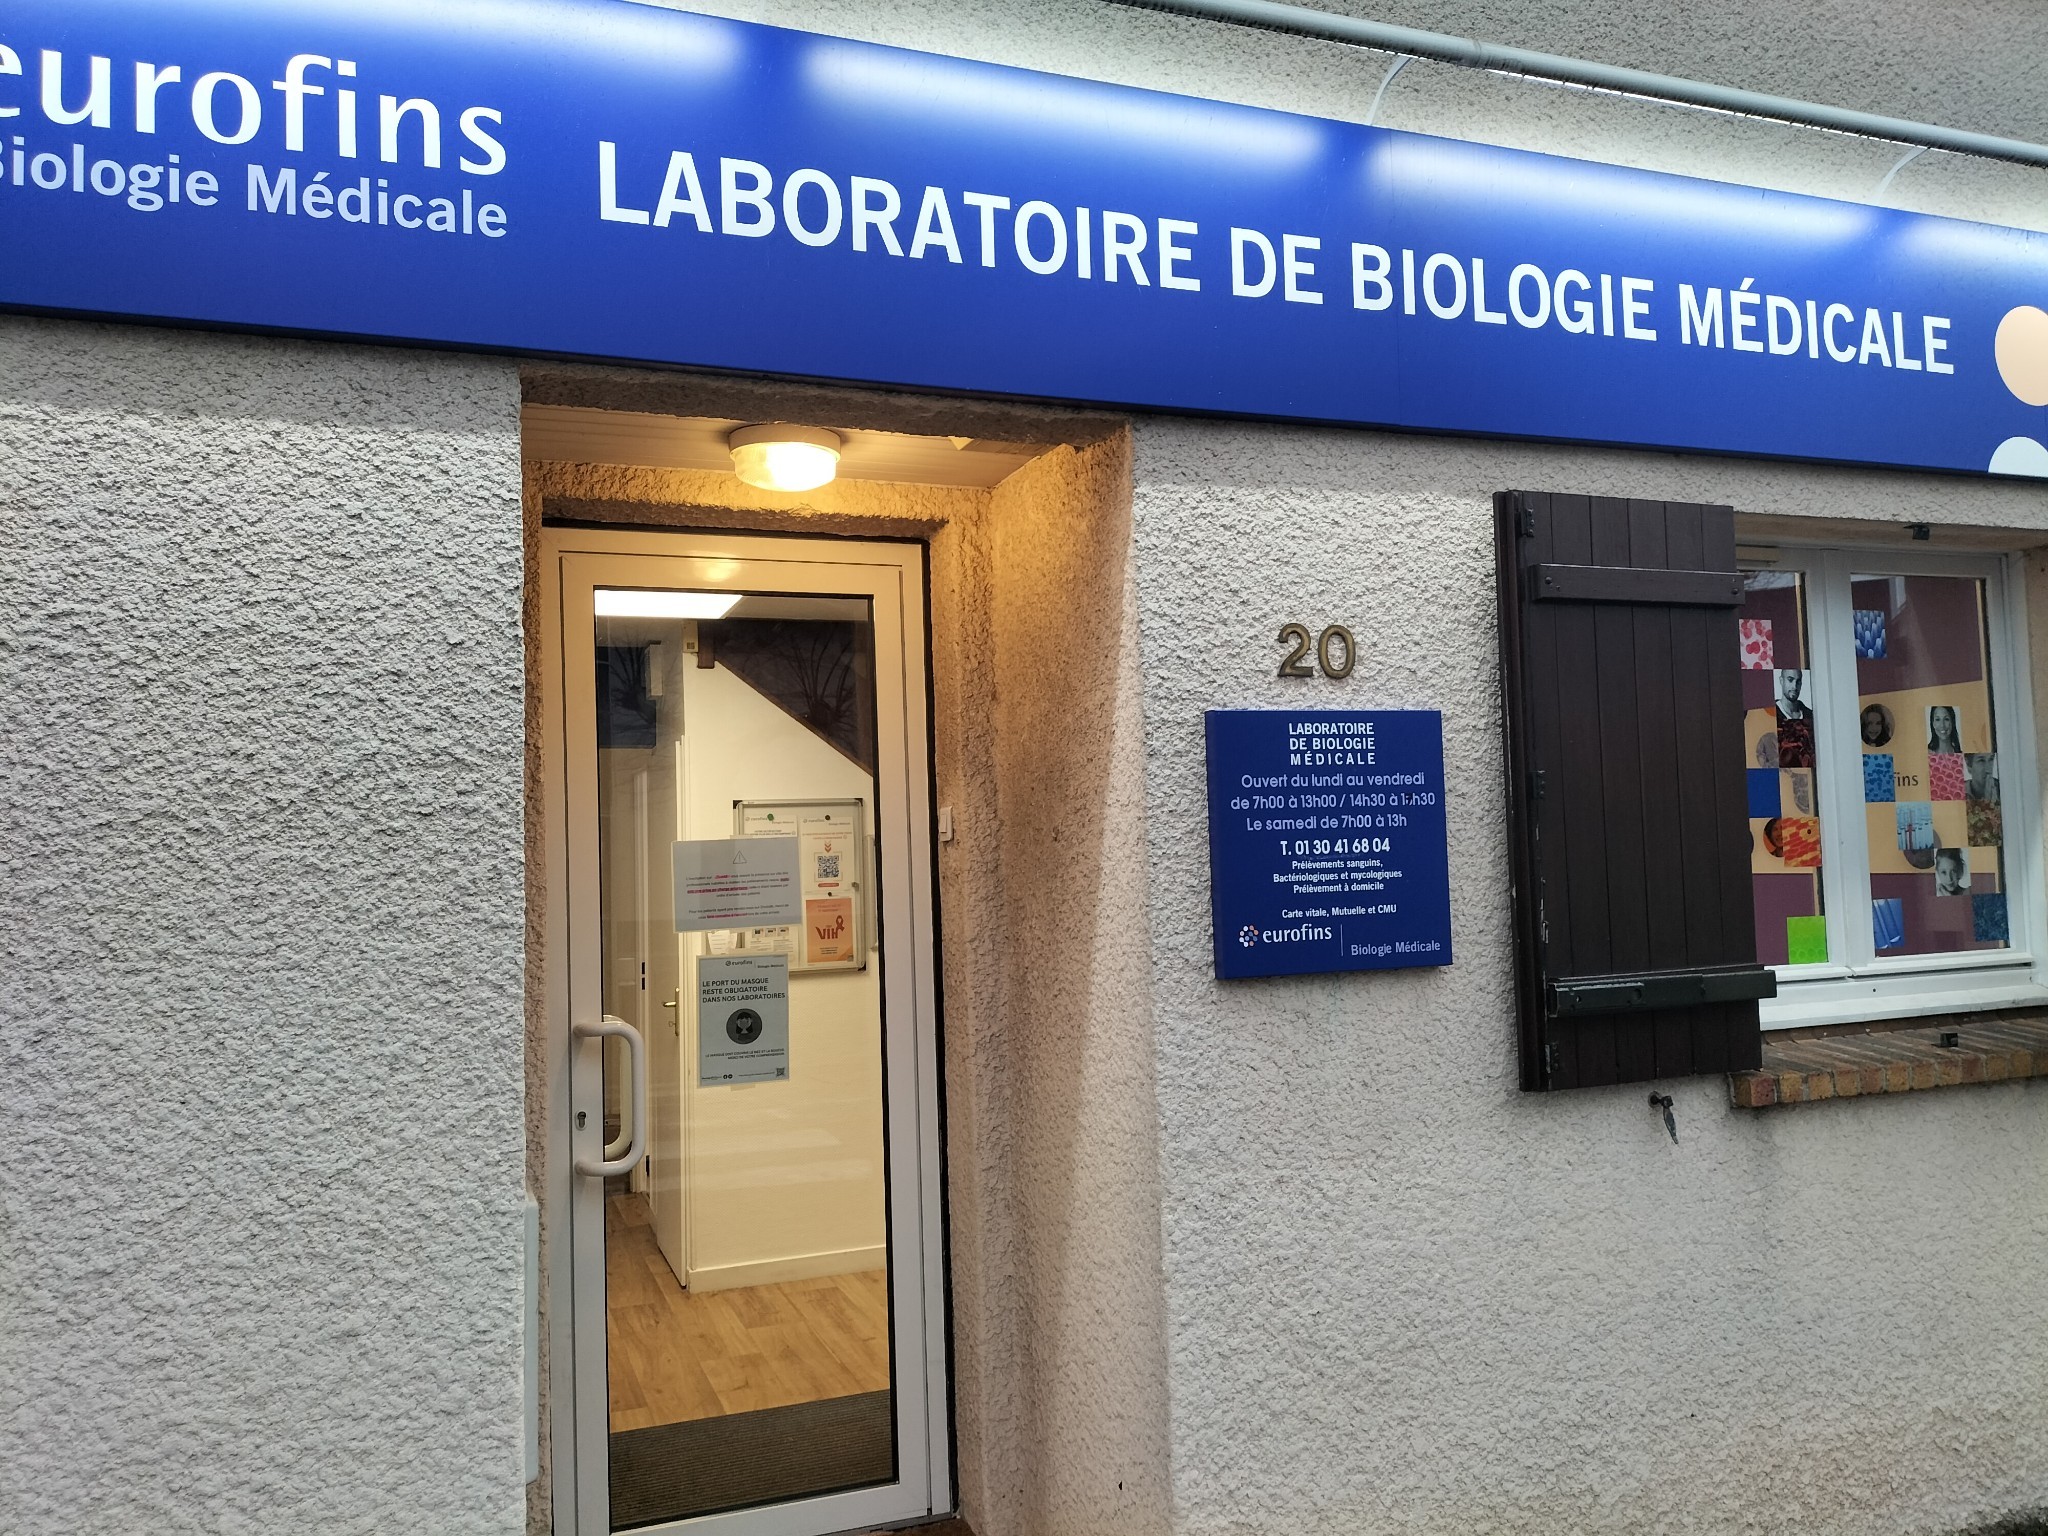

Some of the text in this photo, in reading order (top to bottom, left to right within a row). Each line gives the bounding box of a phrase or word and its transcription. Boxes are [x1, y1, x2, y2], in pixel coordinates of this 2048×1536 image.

[0, 135, 508, 238] iologie Médicale
[599, 140, 1954, 375] LABORATOIRE DE BIOLOGIE MÉDICALE
[1277, 623, 1356, 679] 20
[1288, 722, 1375, 735] LABORATOIRE
[1289, 737, 1376, 750] DE BIOLOGIE
[1290, 751, 1376, 766] MÉDICALE
[1241, 772, 1425, 788] Ouvert du lundi au vendredi
[1230, 797, 1250, 810] de
[1252, 796, 1285, 809] 7h00
[1288, 795, 1298, 808] à
[1301, 794, 1337, 808] 13h00
[1339, 794, 1346, 807] /
[1349, 793, 1386, 807] 14h30
[1389, 793, 1399, 806] à
[1246, 813, 1408, 831] Le samedi de 7h00 à 13h
[1280, 837, 1390, 856] T. 01 30 41 68 04
[1292, 858, 1384, 870] Prélèvements sanguins,
[1273, 870, 1403, 883] Bactériologiques et mycologiques
[1293, 881, 1385, 894] Prélèvement à domicile
[1281, 904, 1397, 918] Carte vitale, Mutuelle et CMU
[815, 923, 842, 939] VIH
[1262, 924, 1333, 944] eurofins
[1351, 940, 1441, 957] Biologie Médicale
[740, 977, 769, 985] MASQUE
[724, 985, 768, 994] OBLIGATOIRE
[737, 992, 786, 1001] LABORATOIRES
